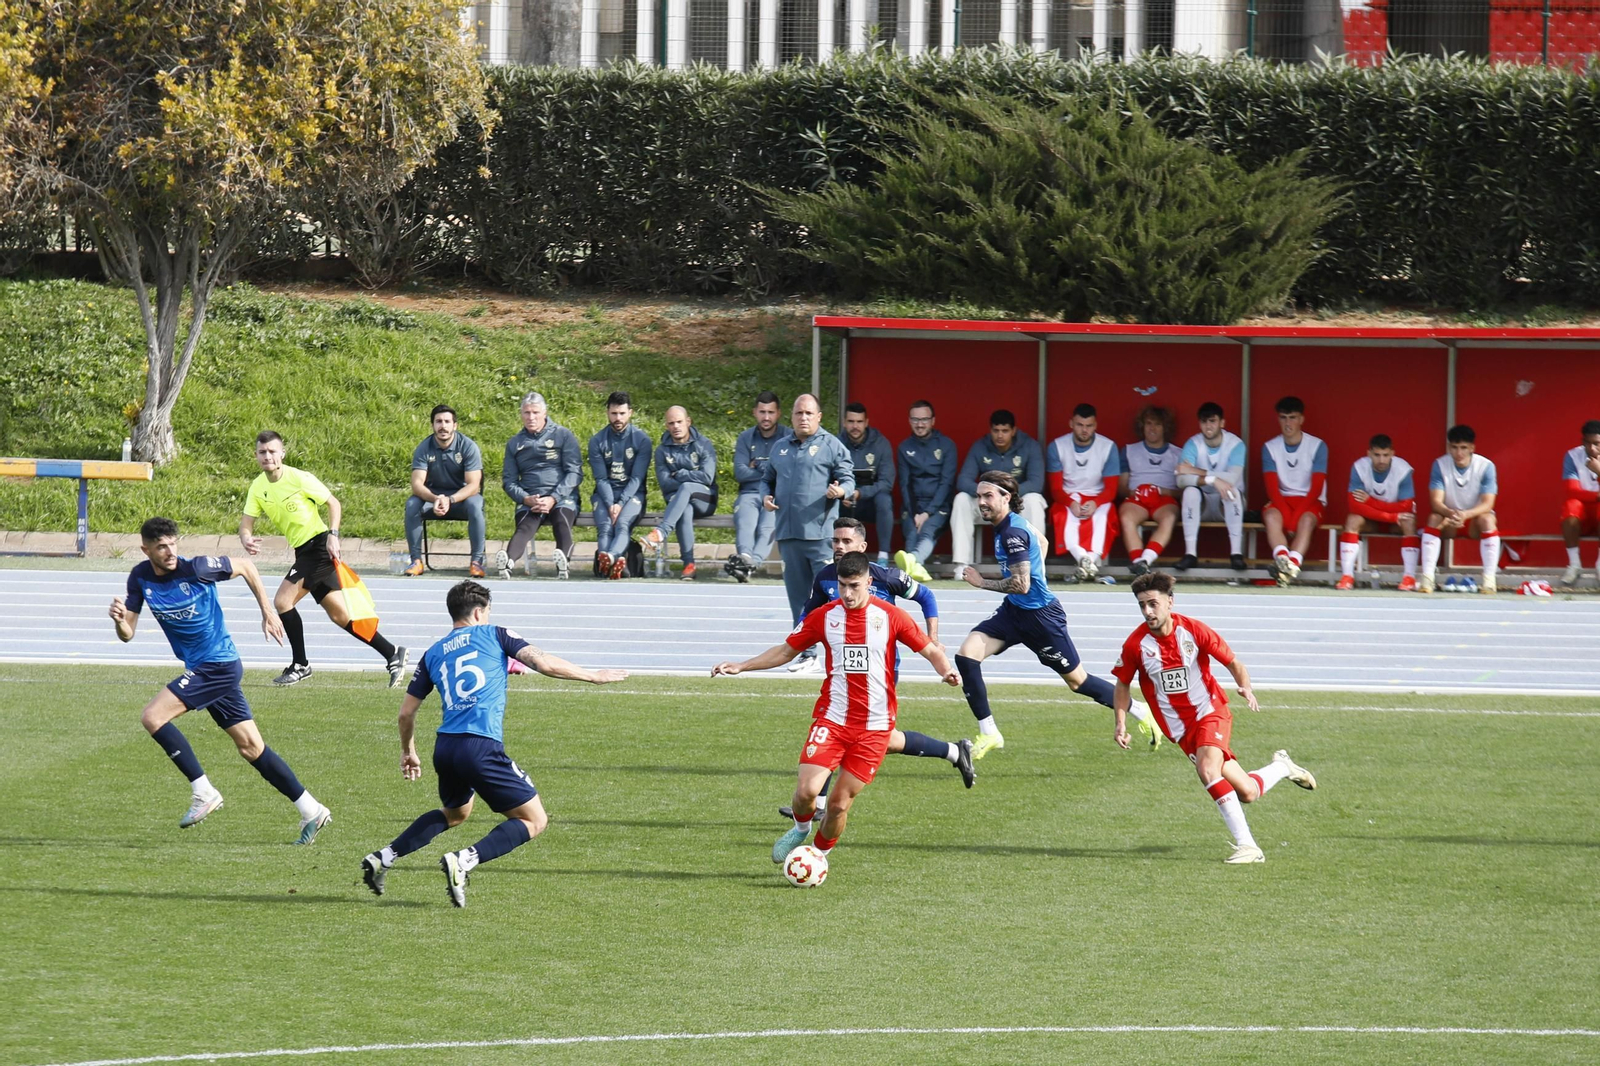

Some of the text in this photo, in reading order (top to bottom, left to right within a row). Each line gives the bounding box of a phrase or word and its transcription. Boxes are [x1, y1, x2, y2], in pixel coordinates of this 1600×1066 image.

[443, 633, 471, 655] BRUNET
[849, 650, 863, 658] DA
[849, 660, 863, 668] ZN
[439, 650, 486, 710] 15
[1167, 672, 1182, 681] DA
[1168, 681, 1183, 689] ZN
[808, 726, 829, 744] 19
